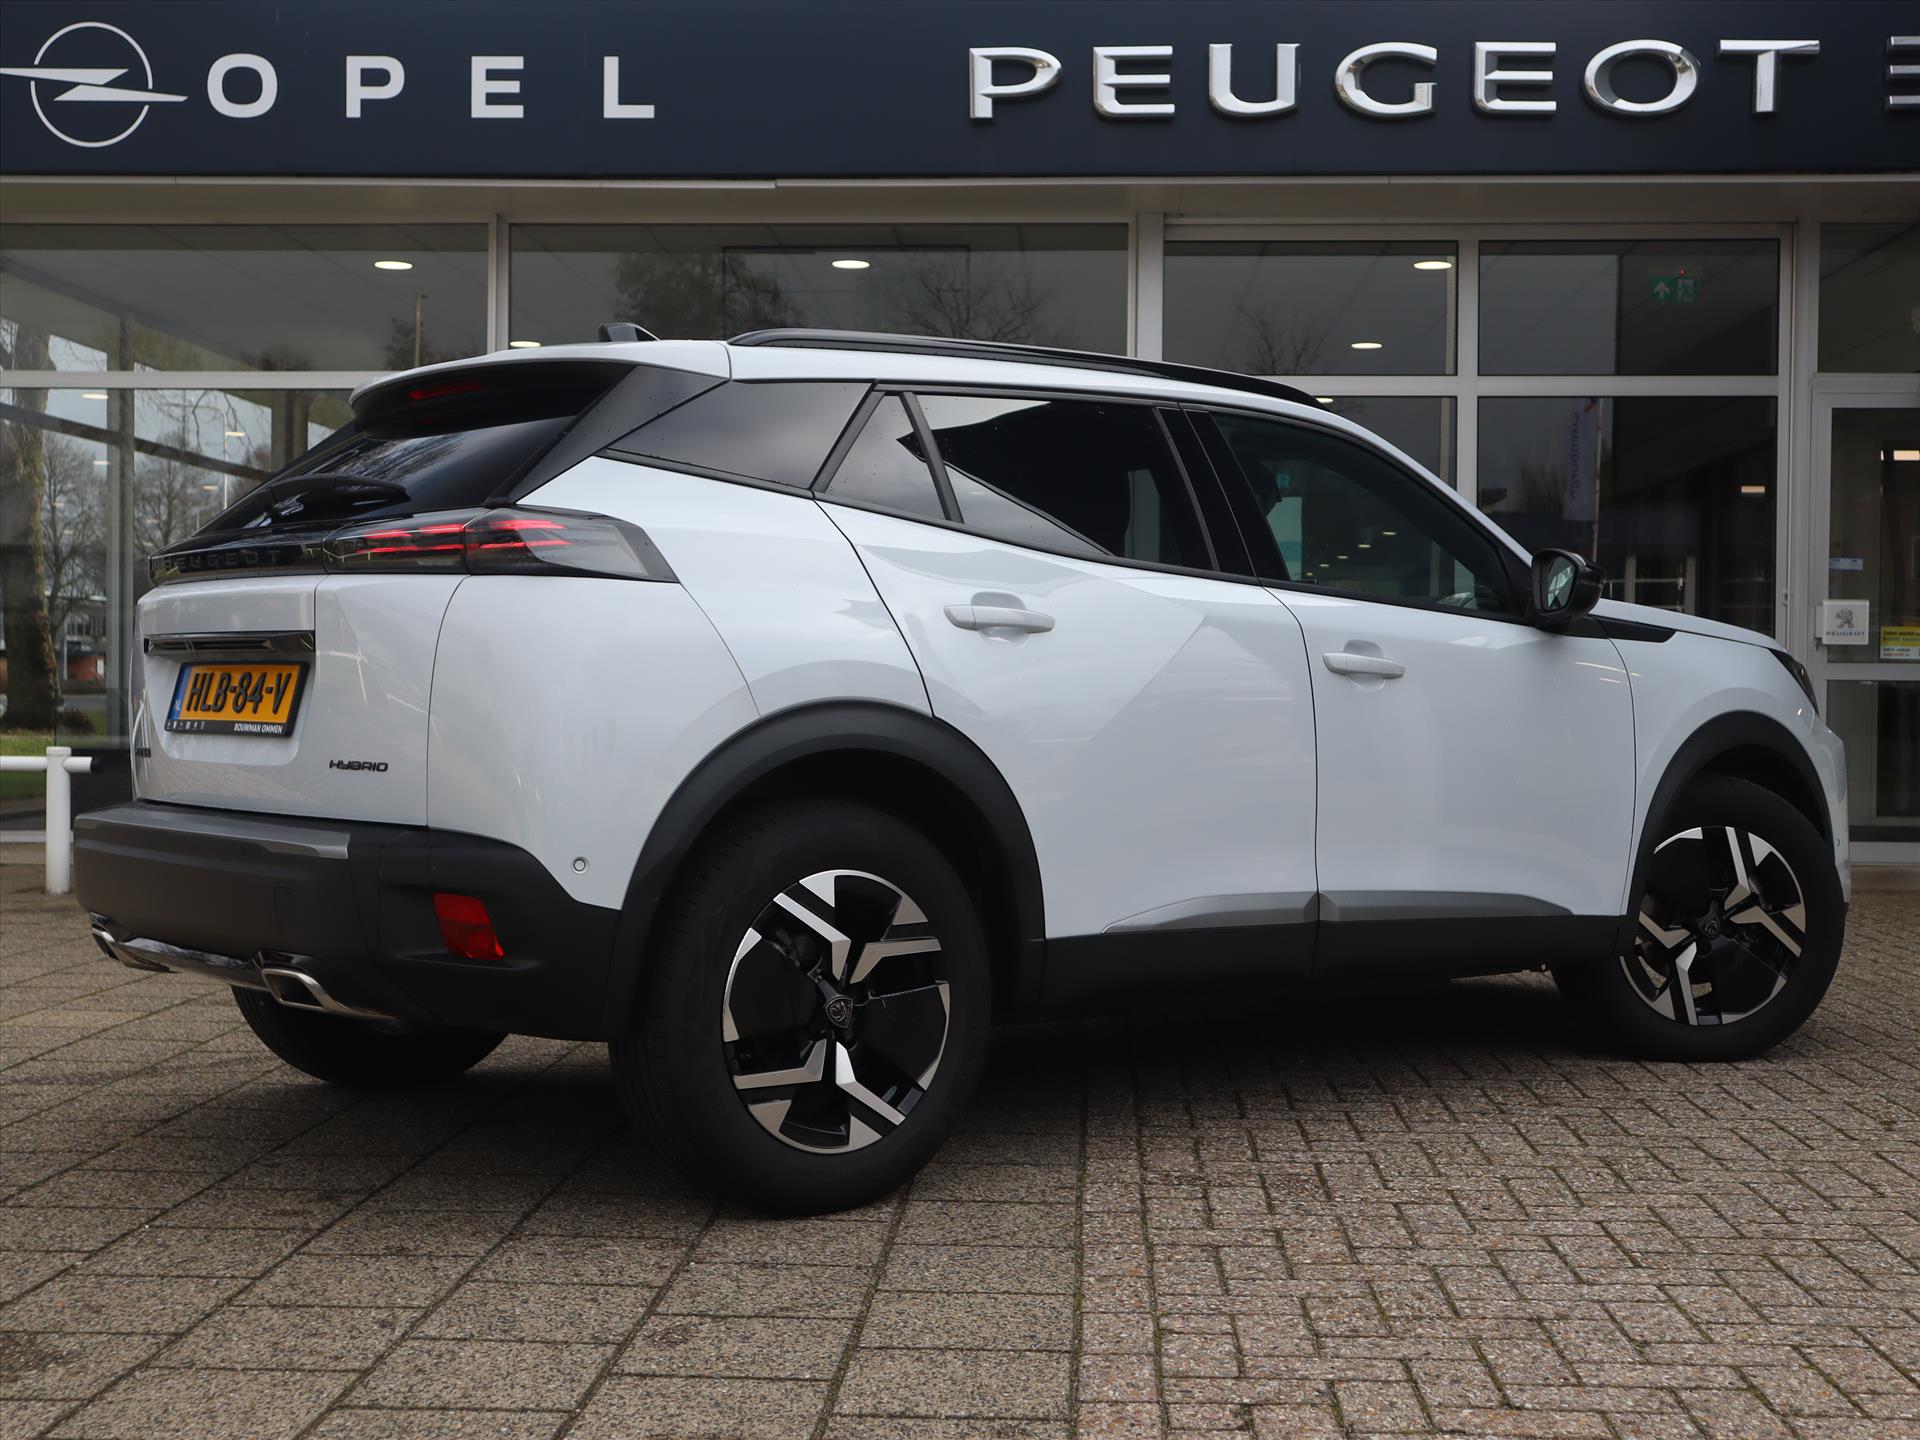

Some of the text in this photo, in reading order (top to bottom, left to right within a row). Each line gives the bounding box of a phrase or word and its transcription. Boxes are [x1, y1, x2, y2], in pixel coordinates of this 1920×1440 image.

[207, 53, 655, 119] OPEL
[968, 39, 1821, 119] PEUGEOT
[161, 549, 281, 570] PEUGEOT
[186, 671, 292, 714] HLB-84-V
[233, 722, 283, 734] BOUWMAN OMMEN
[328, 759, 389, 772] HYBRID
